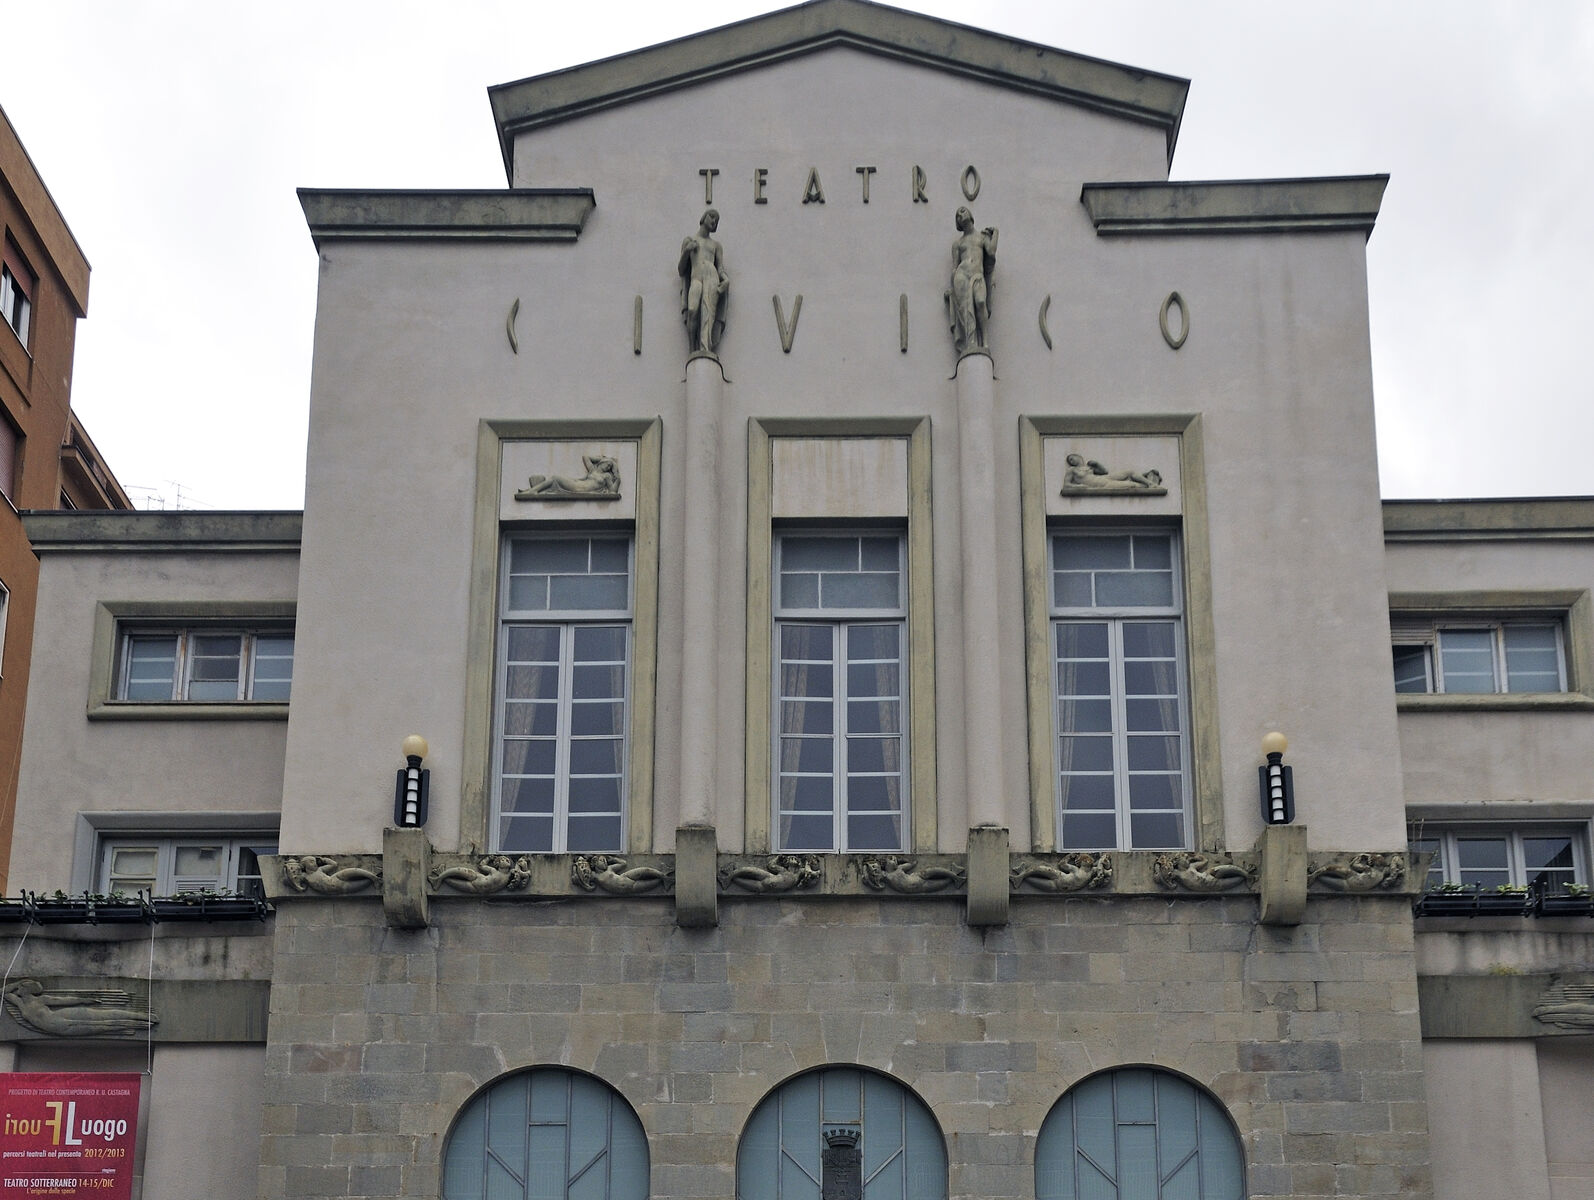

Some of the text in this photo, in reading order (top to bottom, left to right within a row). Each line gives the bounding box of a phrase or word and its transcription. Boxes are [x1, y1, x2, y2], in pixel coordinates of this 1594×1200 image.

[699, 164, 982, 205] TEATRO
[506, 290, 1190, 355] CIVICO
[65, 1101, 127, 1145] Luogo
[3, 1150, 26, 1159] percorsi
[27, 1149, 47, 1158] teatrali
[48, 1150, 57, 1158] nel
[84, 1148, 126, 1160] 2012/2013
[4, 1178, 115, 1190] TEATRO SOTTERRANEO 14-15/DIC
